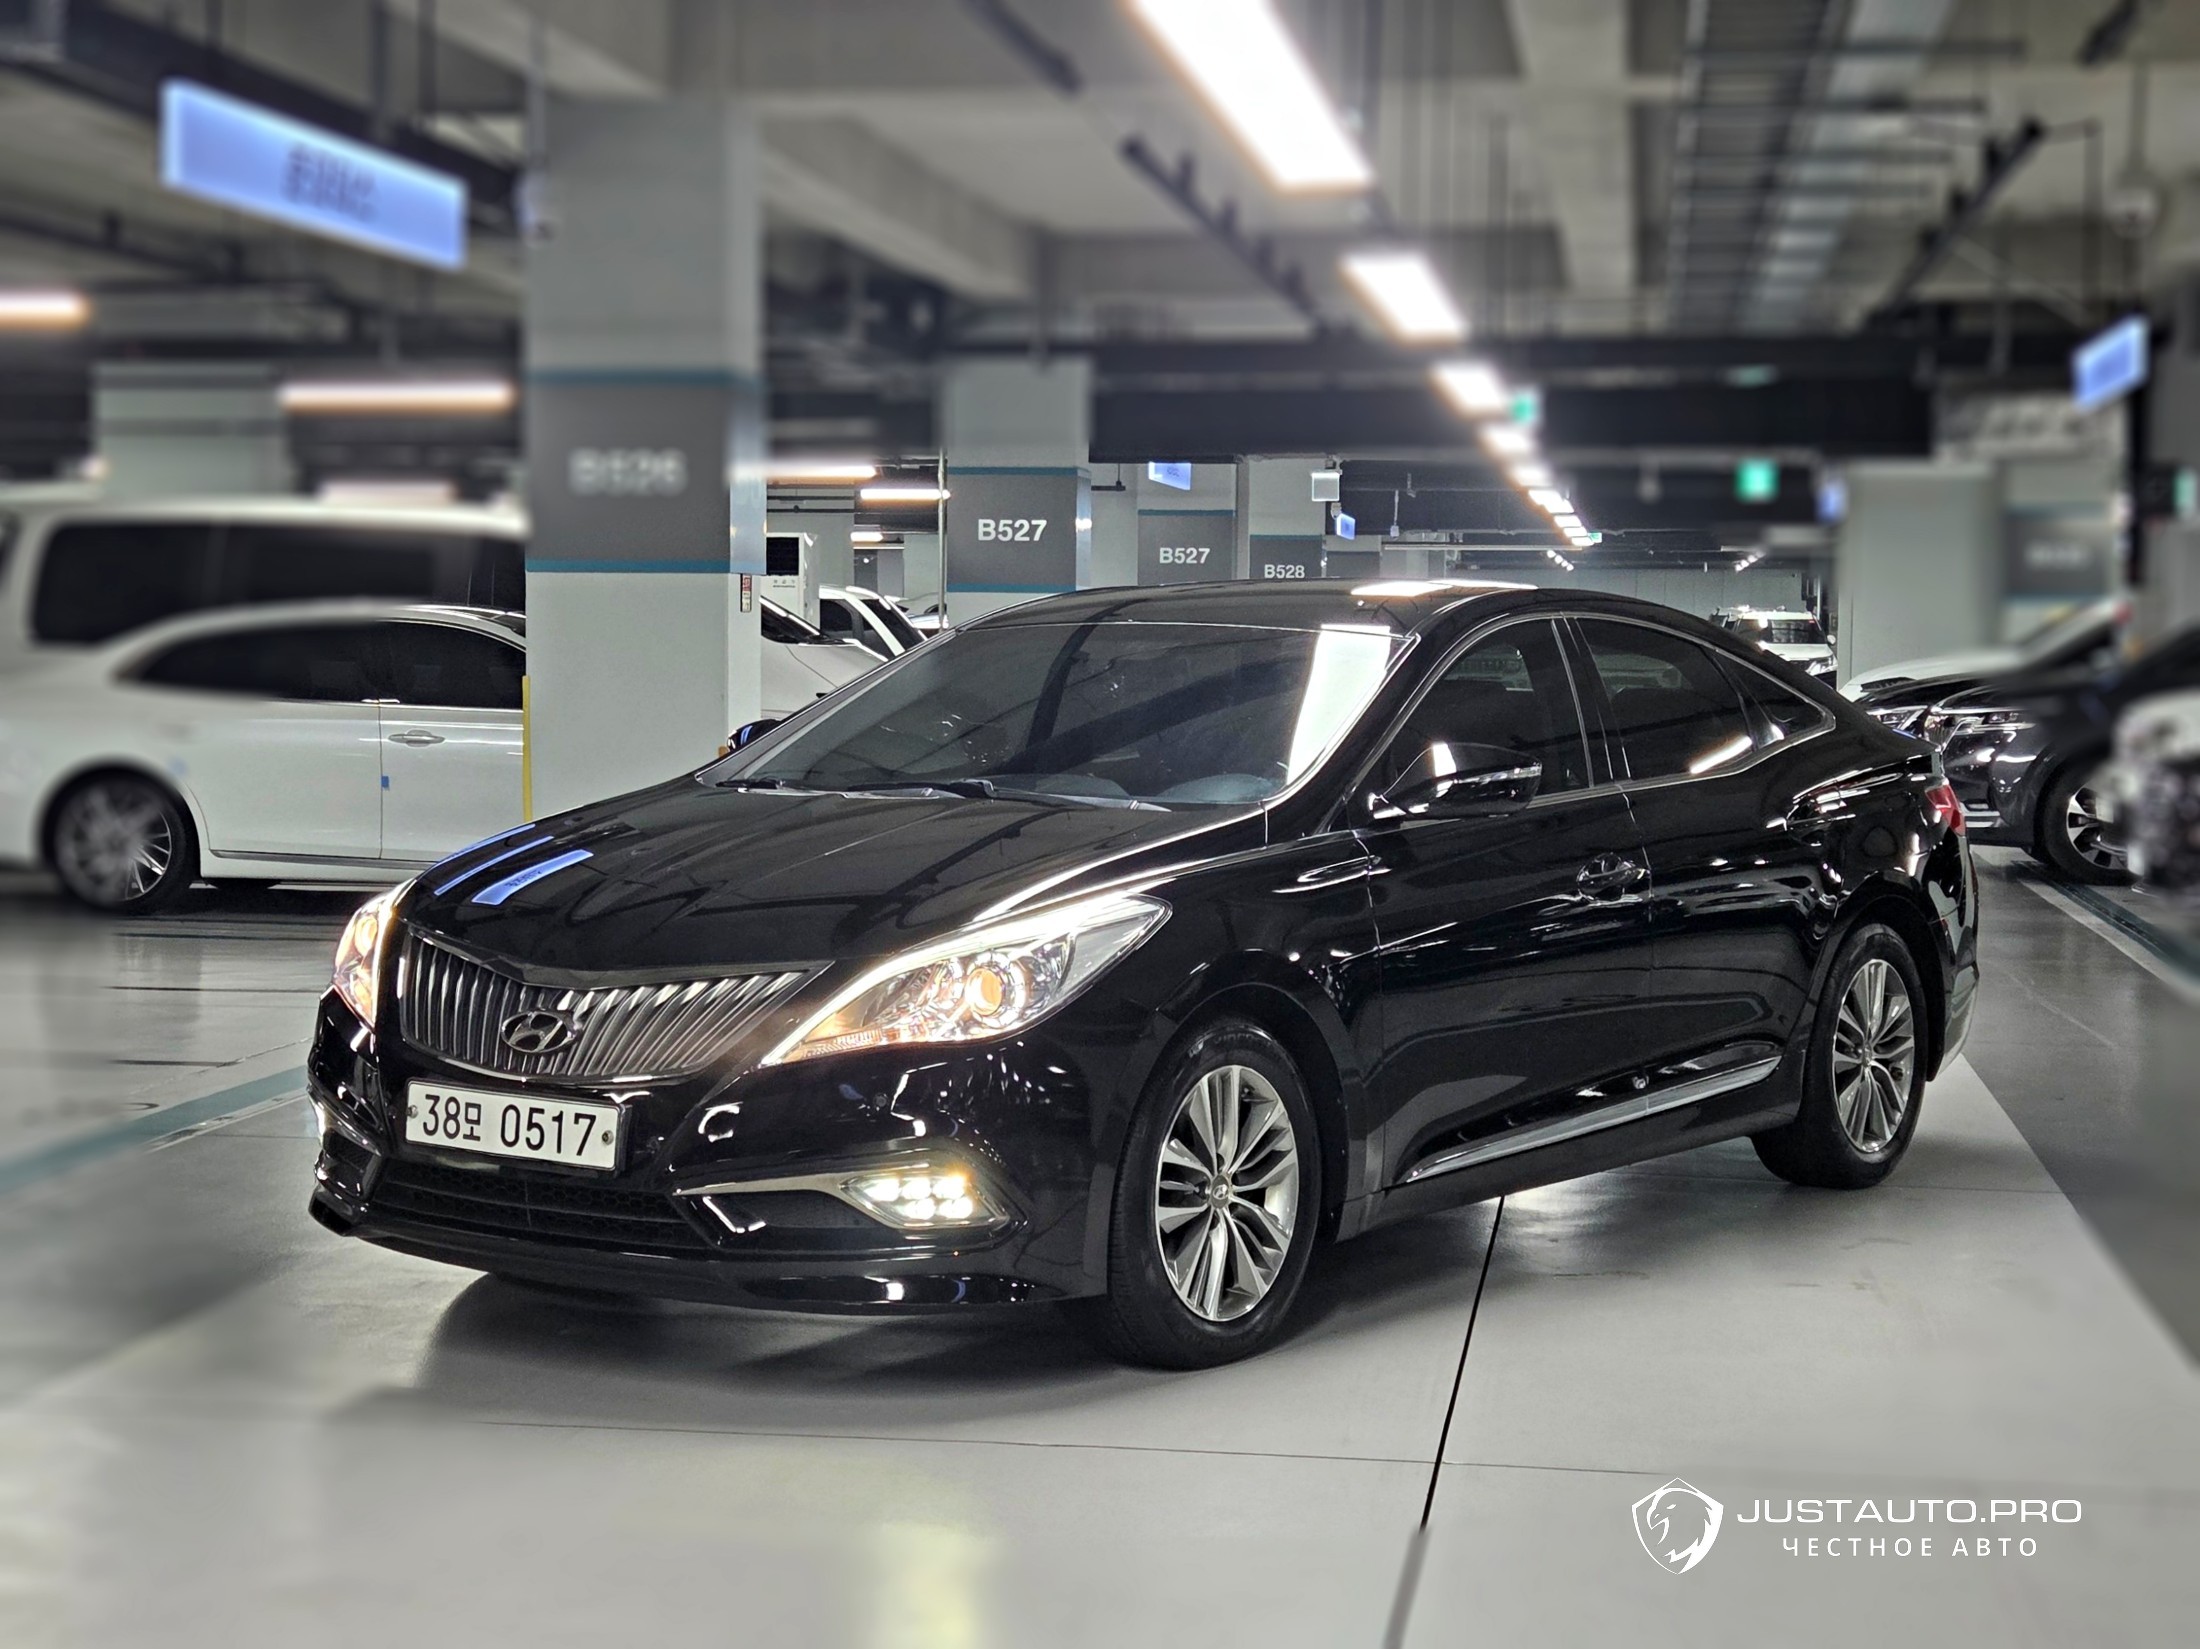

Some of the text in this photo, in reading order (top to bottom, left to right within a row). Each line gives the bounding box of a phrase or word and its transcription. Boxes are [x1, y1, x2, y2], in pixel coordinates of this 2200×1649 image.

[977, 518, 1048, 542] B527
[1159, 547, 1211, 564] B527
[1263, 564, 1306, 579] B528
[422, 1093, 597, 1157] 38모 0517
